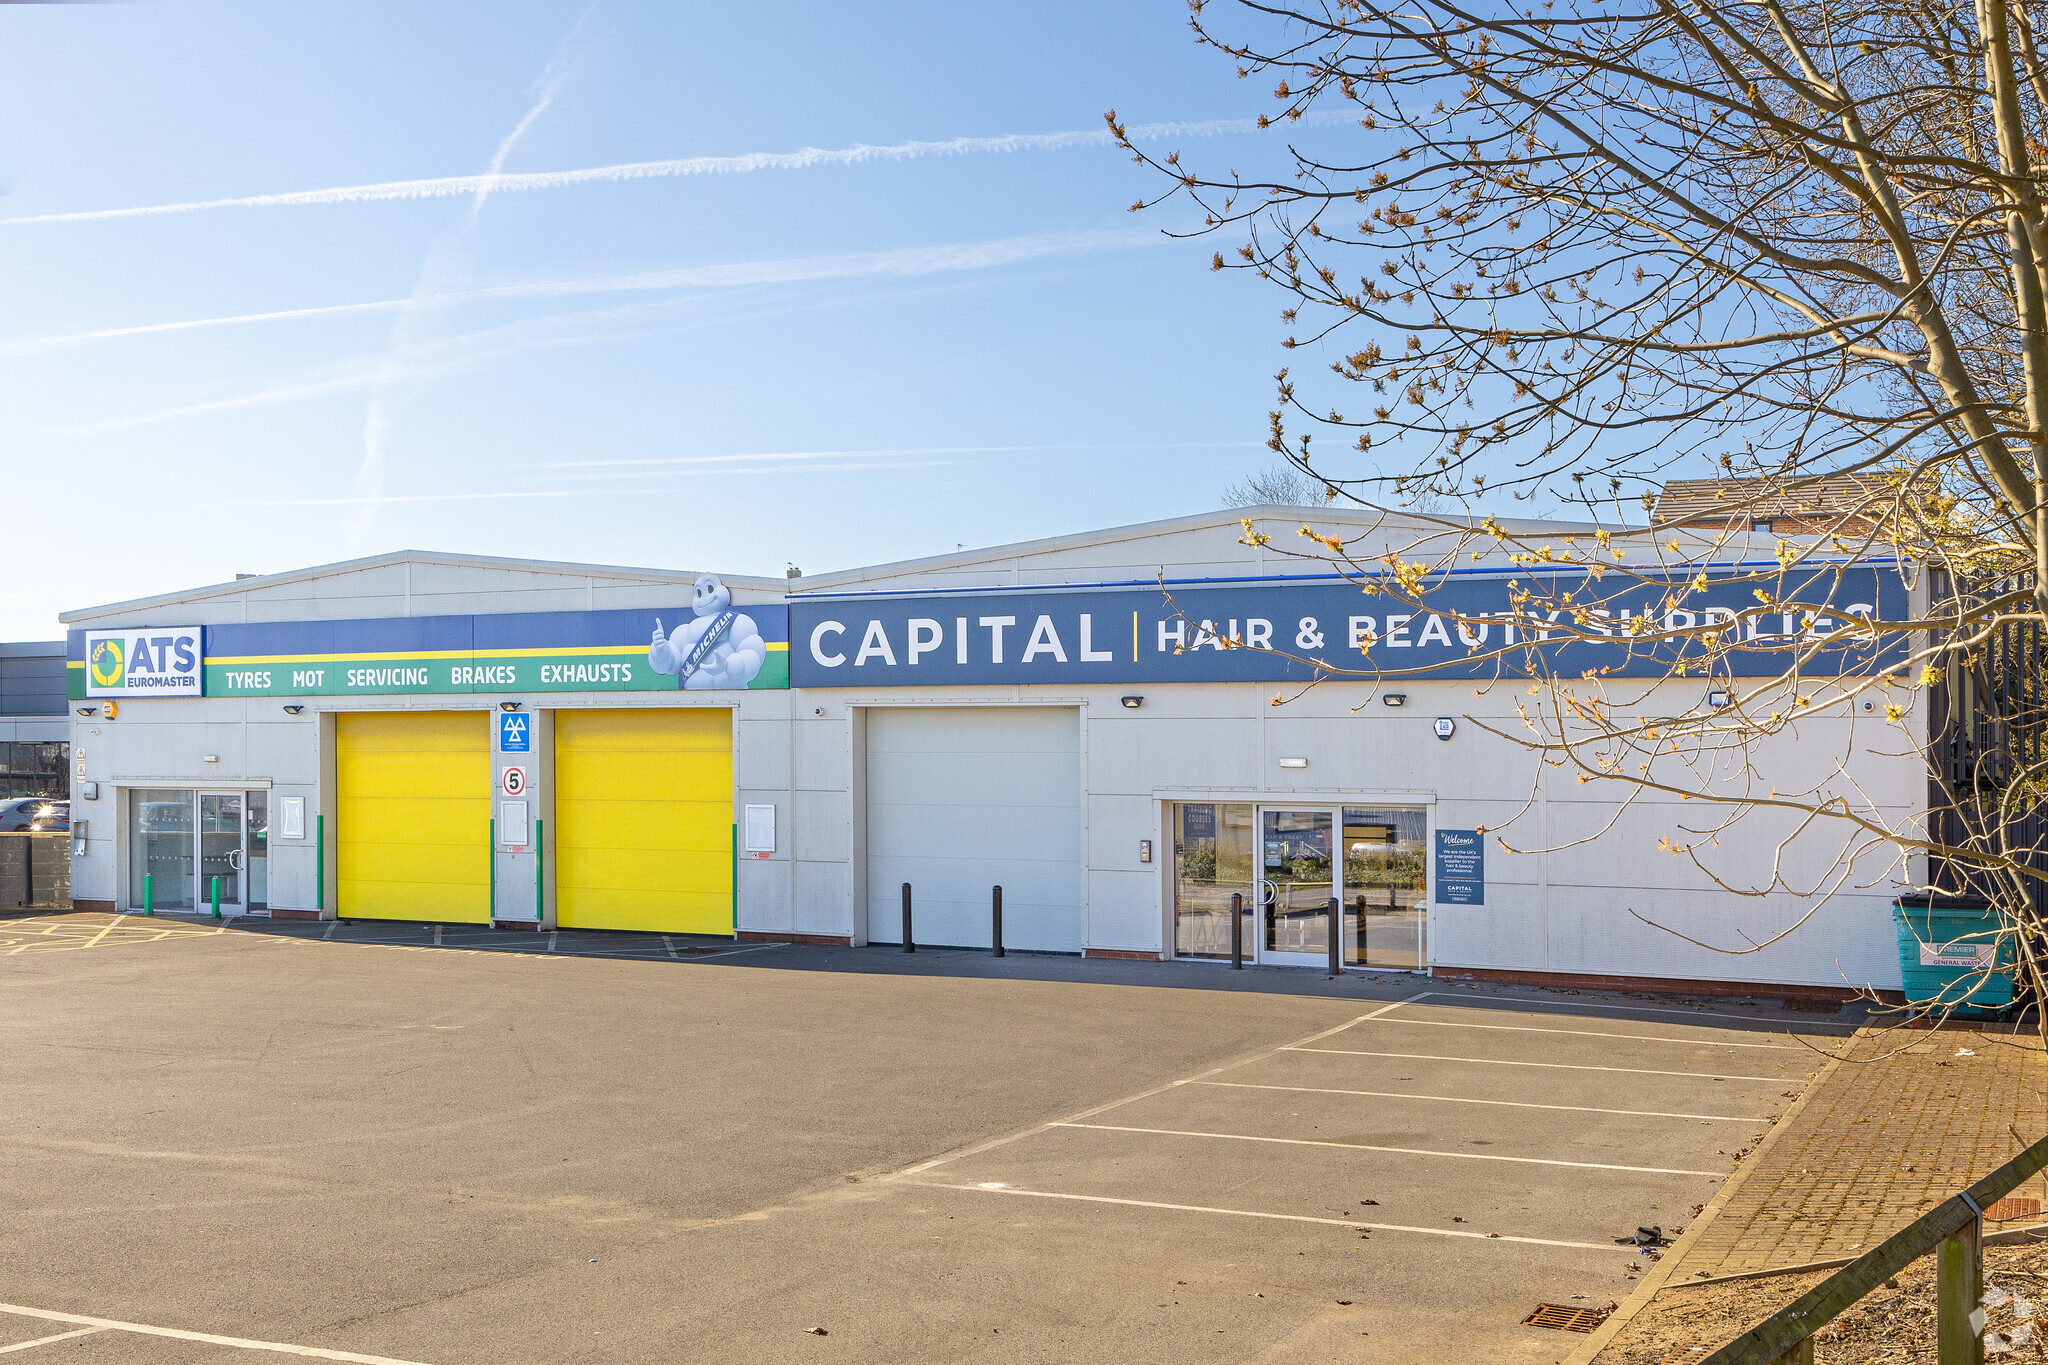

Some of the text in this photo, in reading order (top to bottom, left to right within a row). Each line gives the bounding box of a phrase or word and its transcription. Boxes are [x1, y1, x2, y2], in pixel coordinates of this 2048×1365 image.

[692, 611, 733, 663] MICHELIN
[810, 613, 1113, 667] CAPITAL
[1157, 617, 1273, 652] HAIR
[1295, 616, 1325, 650] &
[1349, 608, 1560, 649] BEAUTY
[127, 636, 196, 674] ATS
[127, 676, 196, 688] EUROMASTER
[226, 663, 632, 689] TYRES MOT SERVICING BRAKES EXHAUSTS
[509, 773, 519, 790] 5
[1188, 814, 1211, 823] COURSES
[1444, 834, 1474, 844] Welcome
